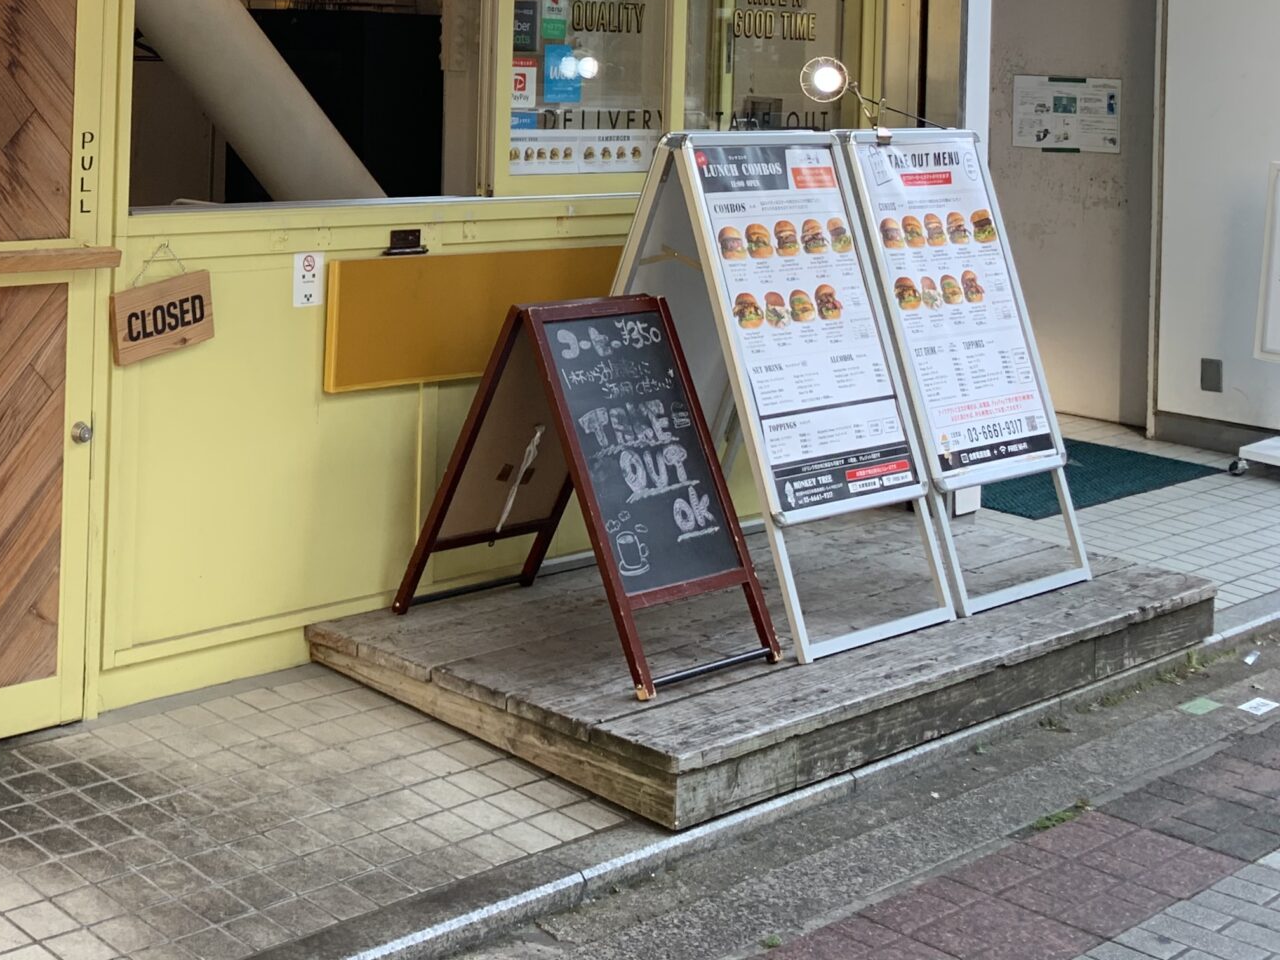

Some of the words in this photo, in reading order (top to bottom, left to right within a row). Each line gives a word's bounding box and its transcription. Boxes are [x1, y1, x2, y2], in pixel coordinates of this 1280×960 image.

[571, 0, 646, 34] QUALITY
[733, 8, 775, 39] GOOD
[781, 12, 816, 41] TIME
[79, 130, 95, 214] PULL
[702, 163, 739, 178] LUNCH
[741, 162, 783, 176] COMBOS
[911, 152, 930, 168] OUT
[933, 151, 960, 166] MENU
[713, 202, 746, 214] COMBOS
[127, 293, 205, 343] CLOSED
[768, 421, 797, 433] TOPPINGS
[967, 418, 1023, 443] 03-6661-9317
[620, 444, 688, 493] OUT
